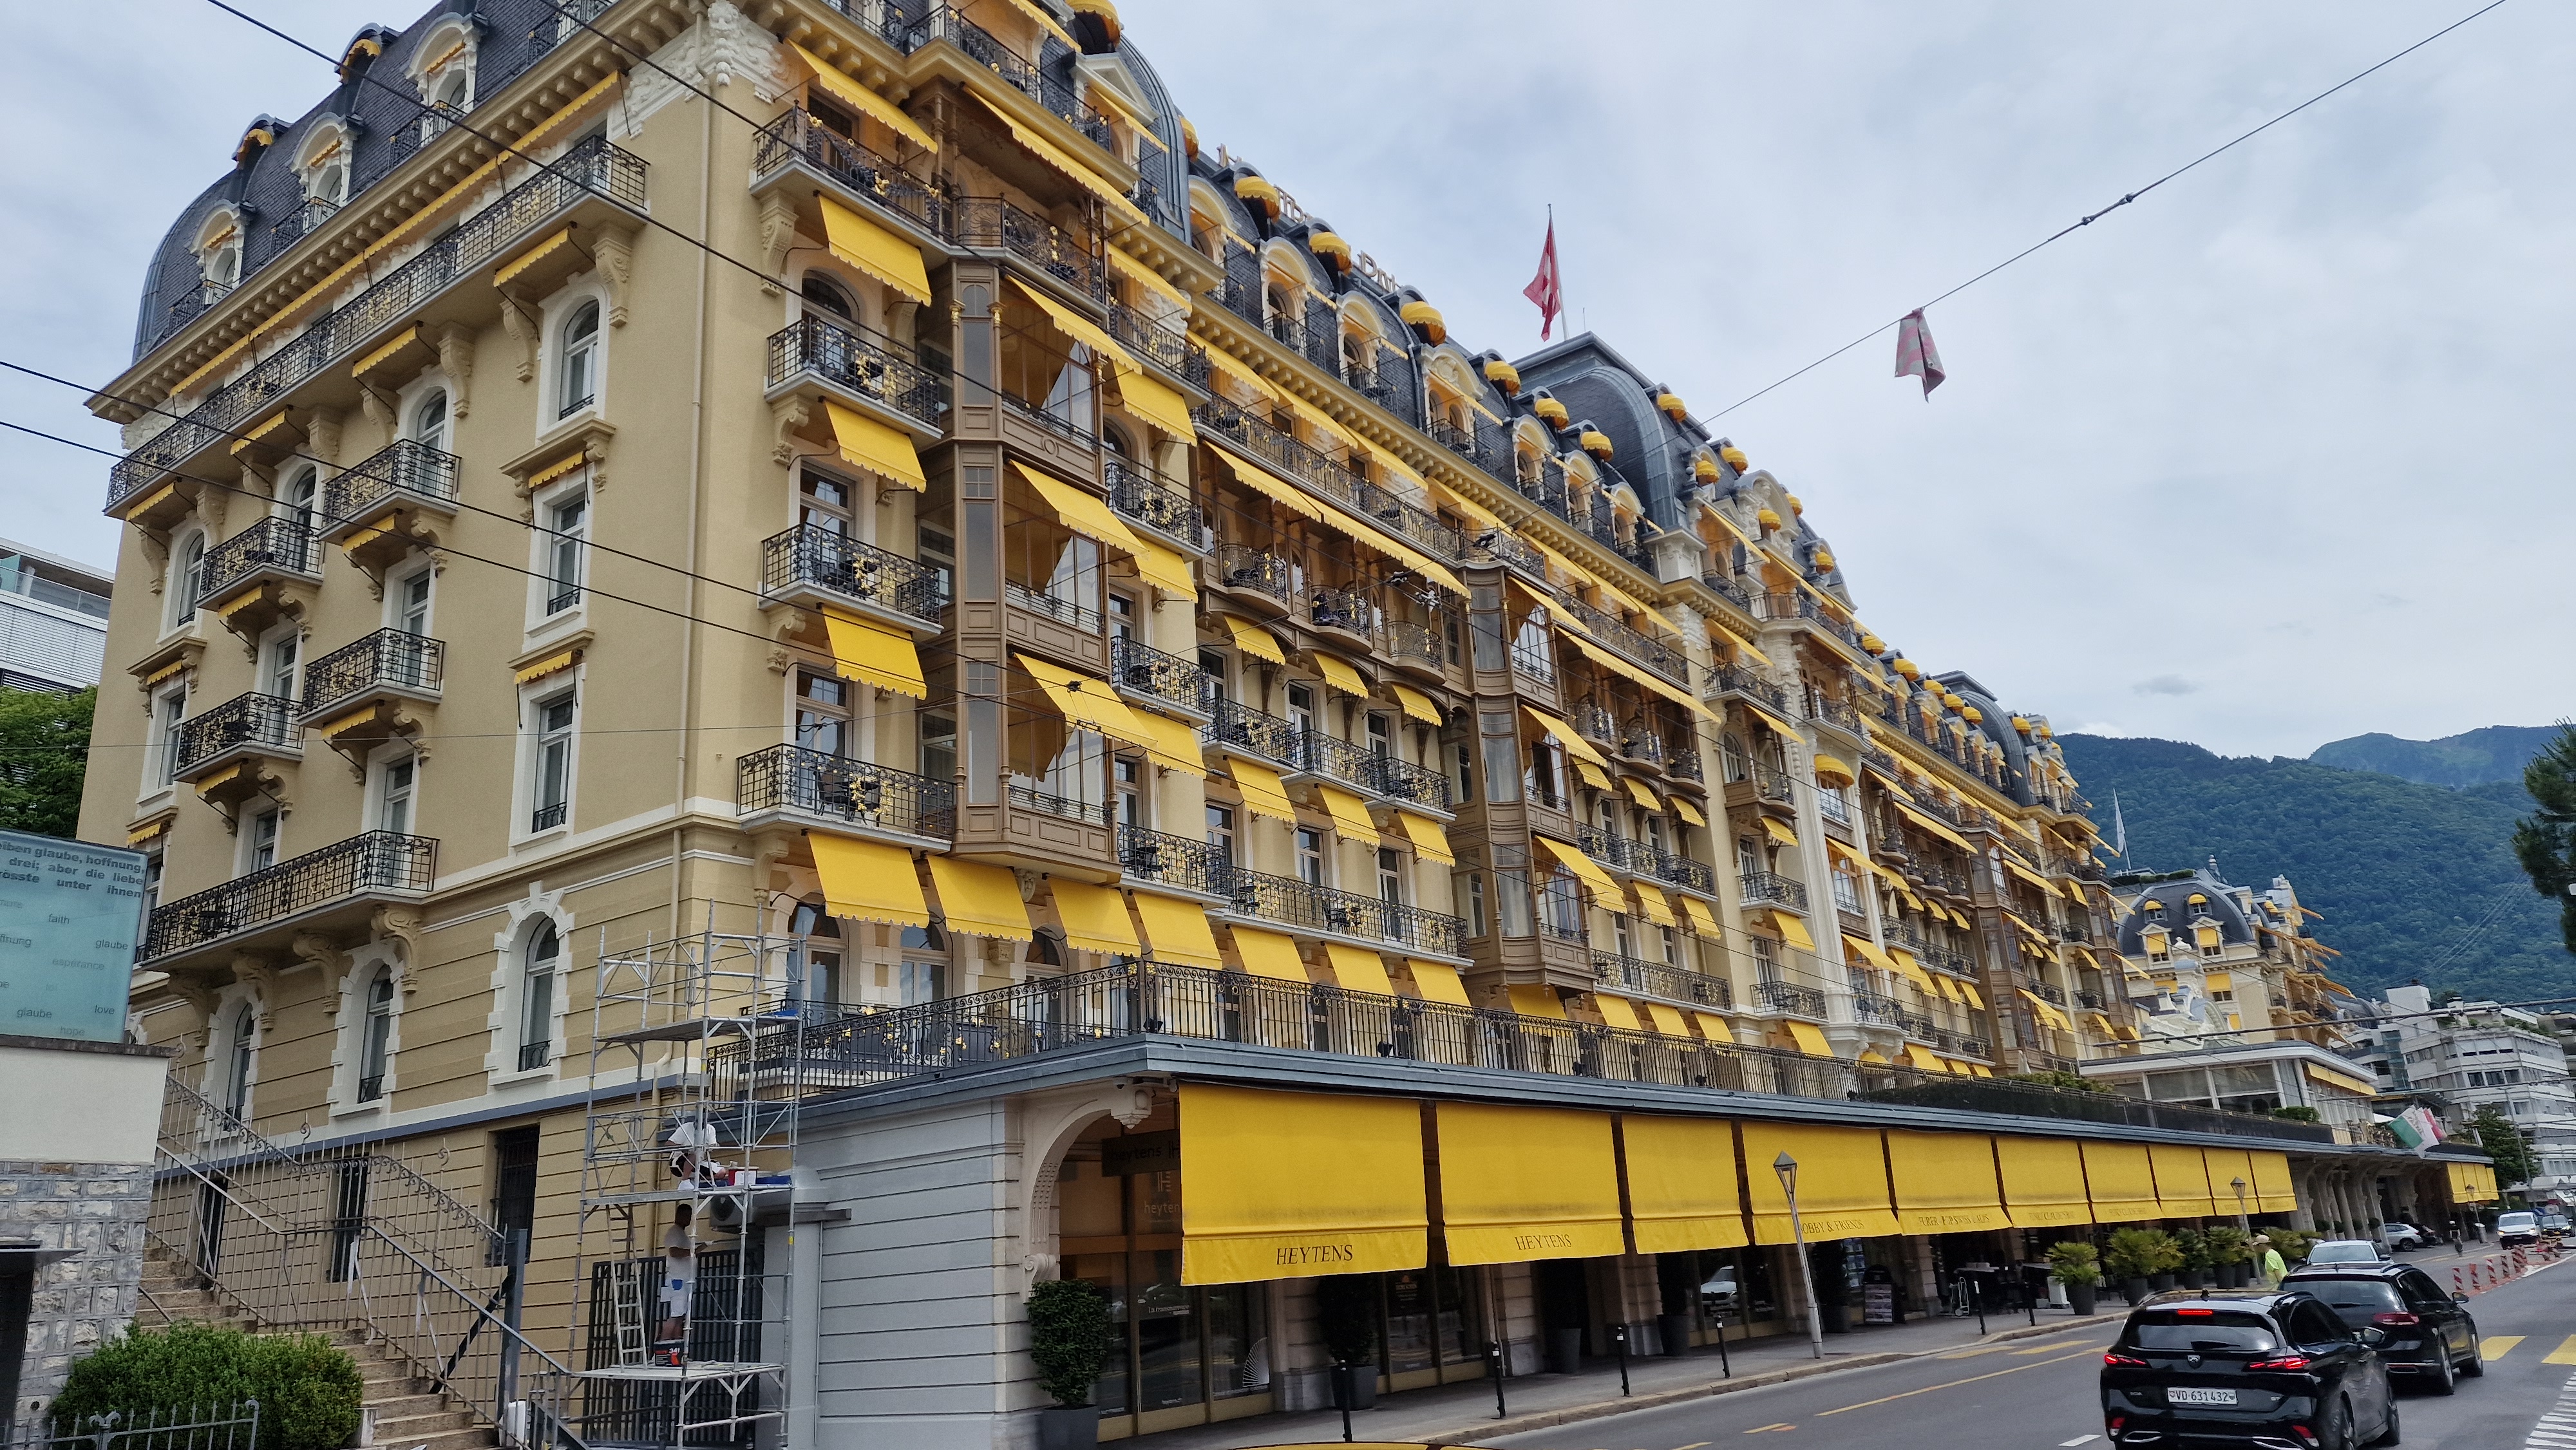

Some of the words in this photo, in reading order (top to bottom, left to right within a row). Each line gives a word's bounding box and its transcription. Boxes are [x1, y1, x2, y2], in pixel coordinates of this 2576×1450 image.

[35, 847, 82, 864] glaube,
[86, 854, 145, 874] hoffnung,
[9, 857, 40, 871] drei;
[48, 864, 79, 875] aber
[86, 869, 105, 880] die
[113, 872, 143, 885] liebe
[57, 879, 92, 890] unter
[107, 885, 141, 898] ihnen
[48, 914, 70, 924] faith
[95, 939, 128, 950] glaube
[17, 1007, 52, 1018] glaube
[95, 1004, 115, 1015] love
[60, 1026, 85, 1037] hope
[1144, 1200, 1180, 1216] heyten
[1826, 1221, 1834, 1232] &
[1834, 1219, 1864, 1230] FRIENDS
[1514, 1234, 1572, 1250] HEYTENS
[1276, 1244, 1353, 1265] HEYTENS
[2176, 1390, 2188, 1400] VD
[2191, 1391, 2228, 1402] 631432
